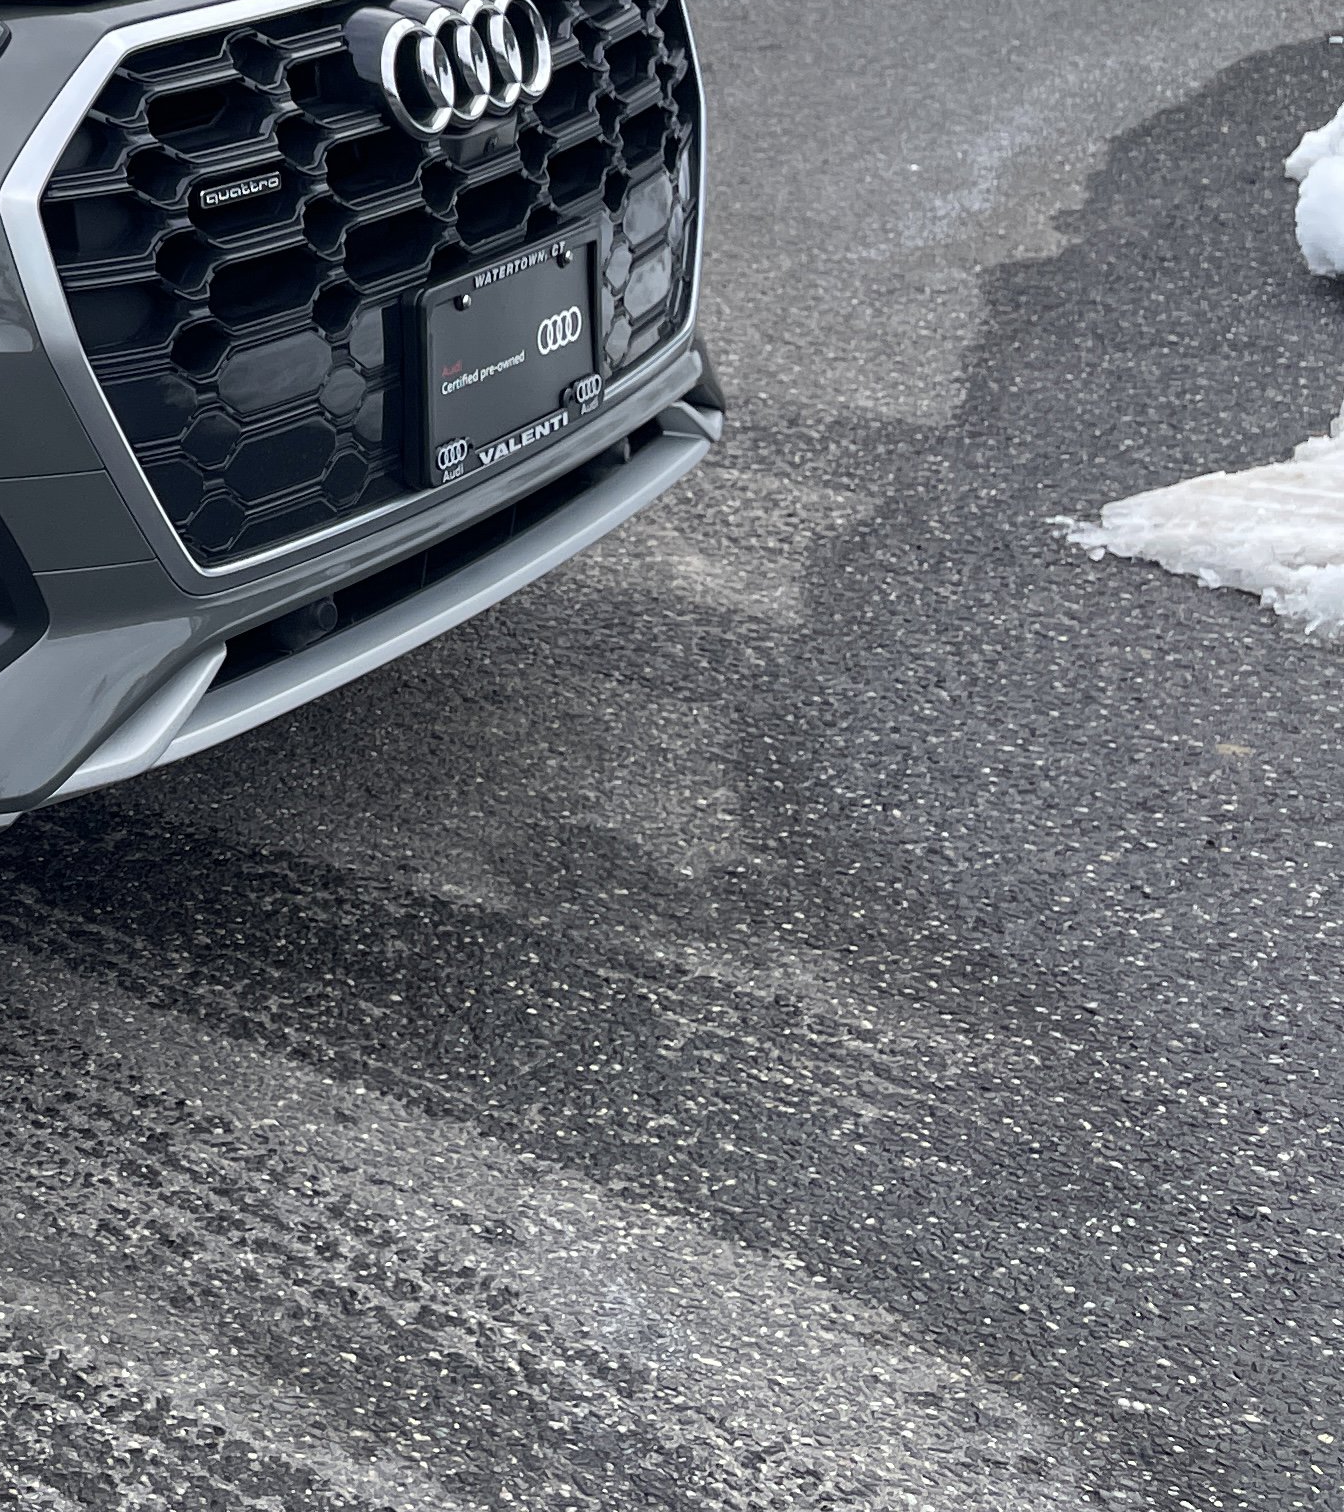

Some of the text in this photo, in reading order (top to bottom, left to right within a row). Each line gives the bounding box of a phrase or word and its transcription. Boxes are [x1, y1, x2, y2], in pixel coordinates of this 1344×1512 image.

[205, 177, 279, 204] quattro
[474, 249, 548, 288] WATERTOWN,
[441, 350, 525, 395] Certified pre-owned
[580, 396, 599, 415] Audi
[478, 411, 569, 465] VALENTI
[442, 462, 464, 484] Audi
